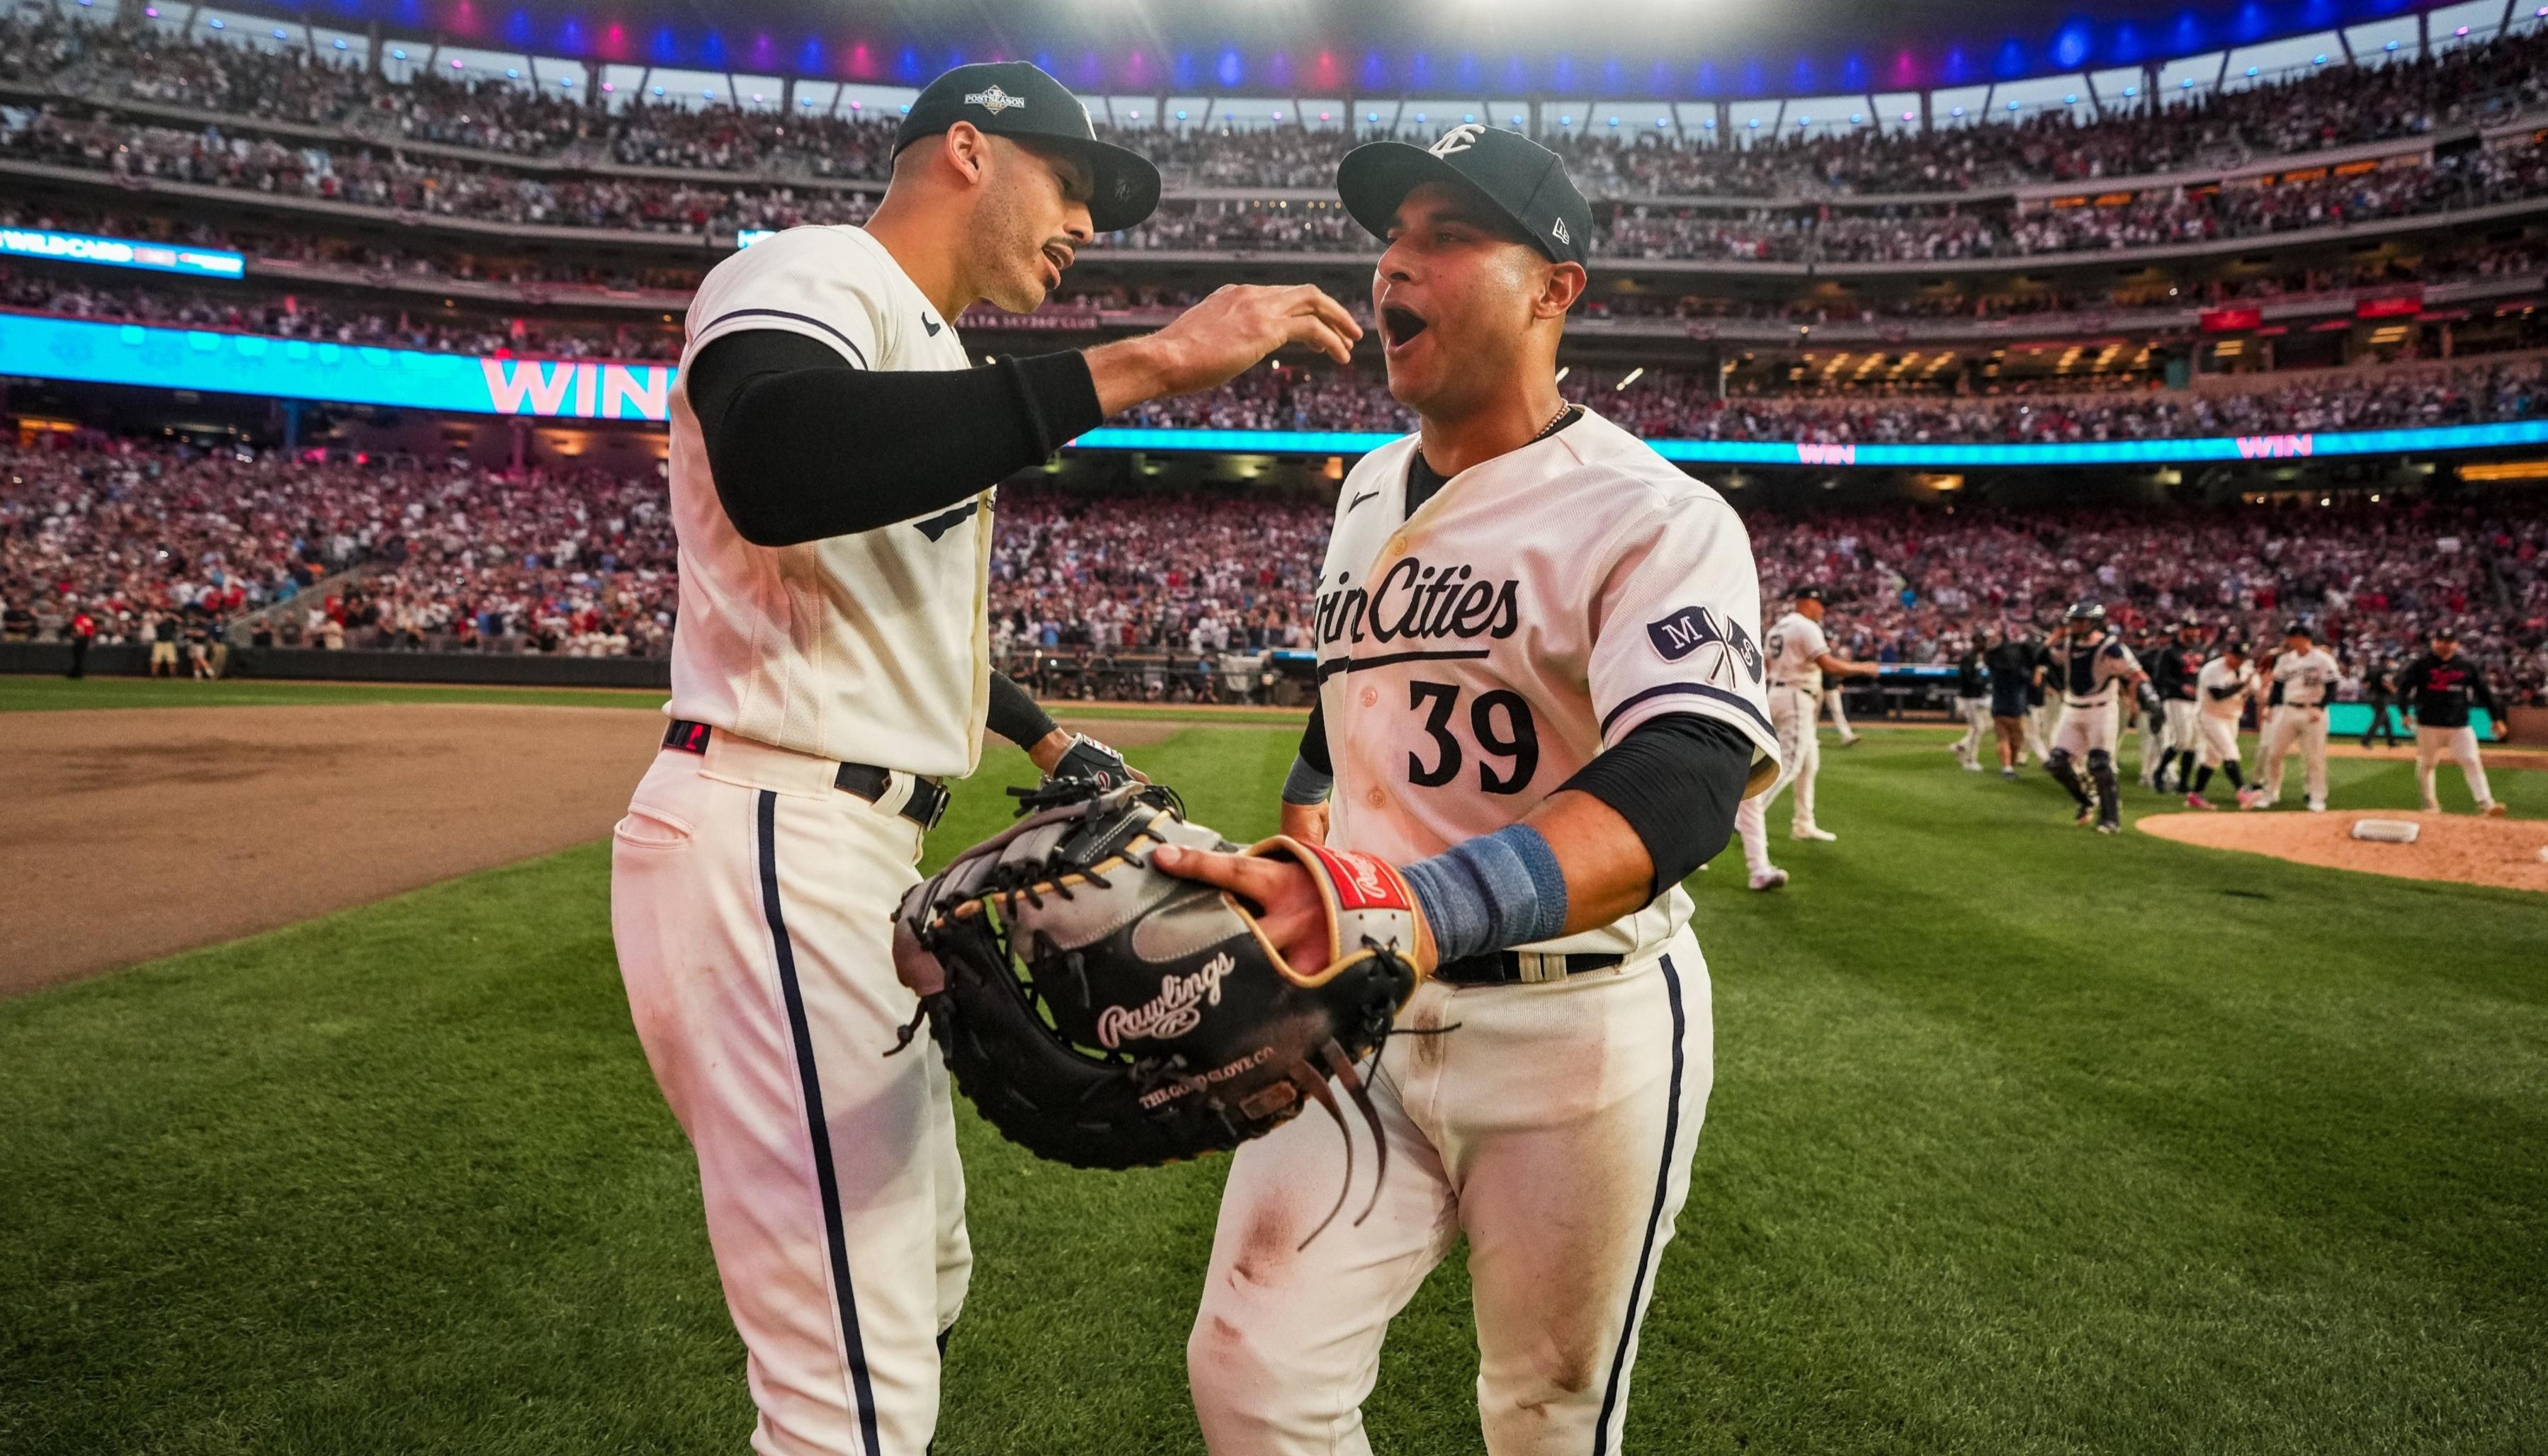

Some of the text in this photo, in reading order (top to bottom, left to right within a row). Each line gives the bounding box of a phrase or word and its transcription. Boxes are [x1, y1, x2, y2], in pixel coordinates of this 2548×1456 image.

[965, 93, 1024, 107] POSTSEASON
[480, 358, 668, 421] WIN
[1797, 443, 1855, 465] WIN
[2236, 433, 2312, 459] WIN
[1369, 557, 1519, 643] Cities
[1661, 615, 1703, 649] M
[1408, 680, 1539, 795] 39
[1098, 951, 1235, 1049] Rawlings
[1139, 1088, 1170, 1109] THE
[1169, 1074, 1207, 1098] GOD
[1207, 1057, 1255, 1083] GLOVE
